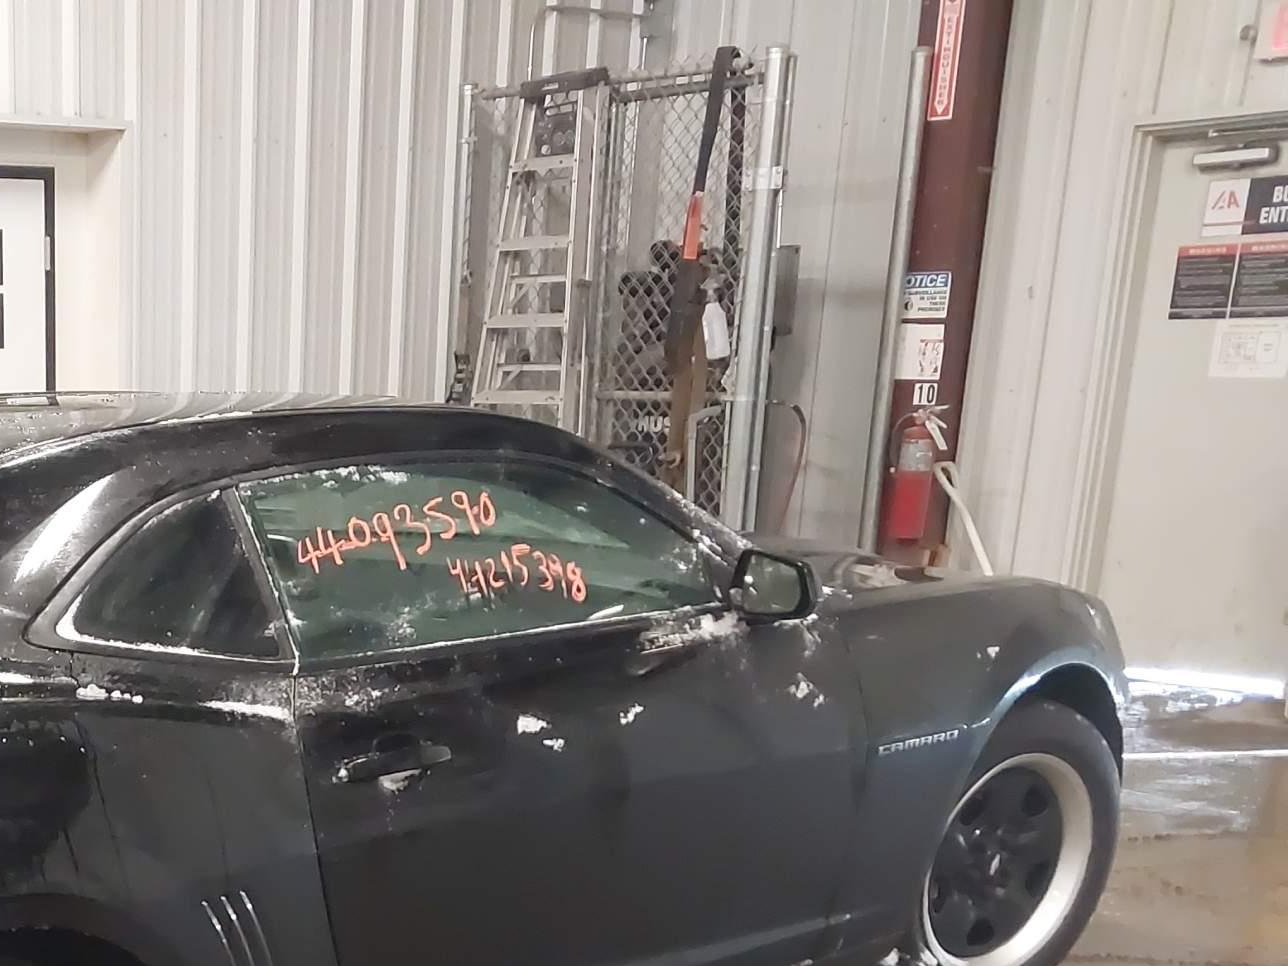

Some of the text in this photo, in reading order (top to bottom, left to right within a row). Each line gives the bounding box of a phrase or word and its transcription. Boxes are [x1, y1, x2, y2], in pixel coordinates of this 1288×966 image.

[1259, 206, 1288, 224] ENT
[905, 274, 948, 288] OTICE
[918, 384, 935, 404] 10
[297, 490, 496, 574] 44093590
[446, 543, 587, 602] 44215398
[878, 729, 959, 756] CAMARO
